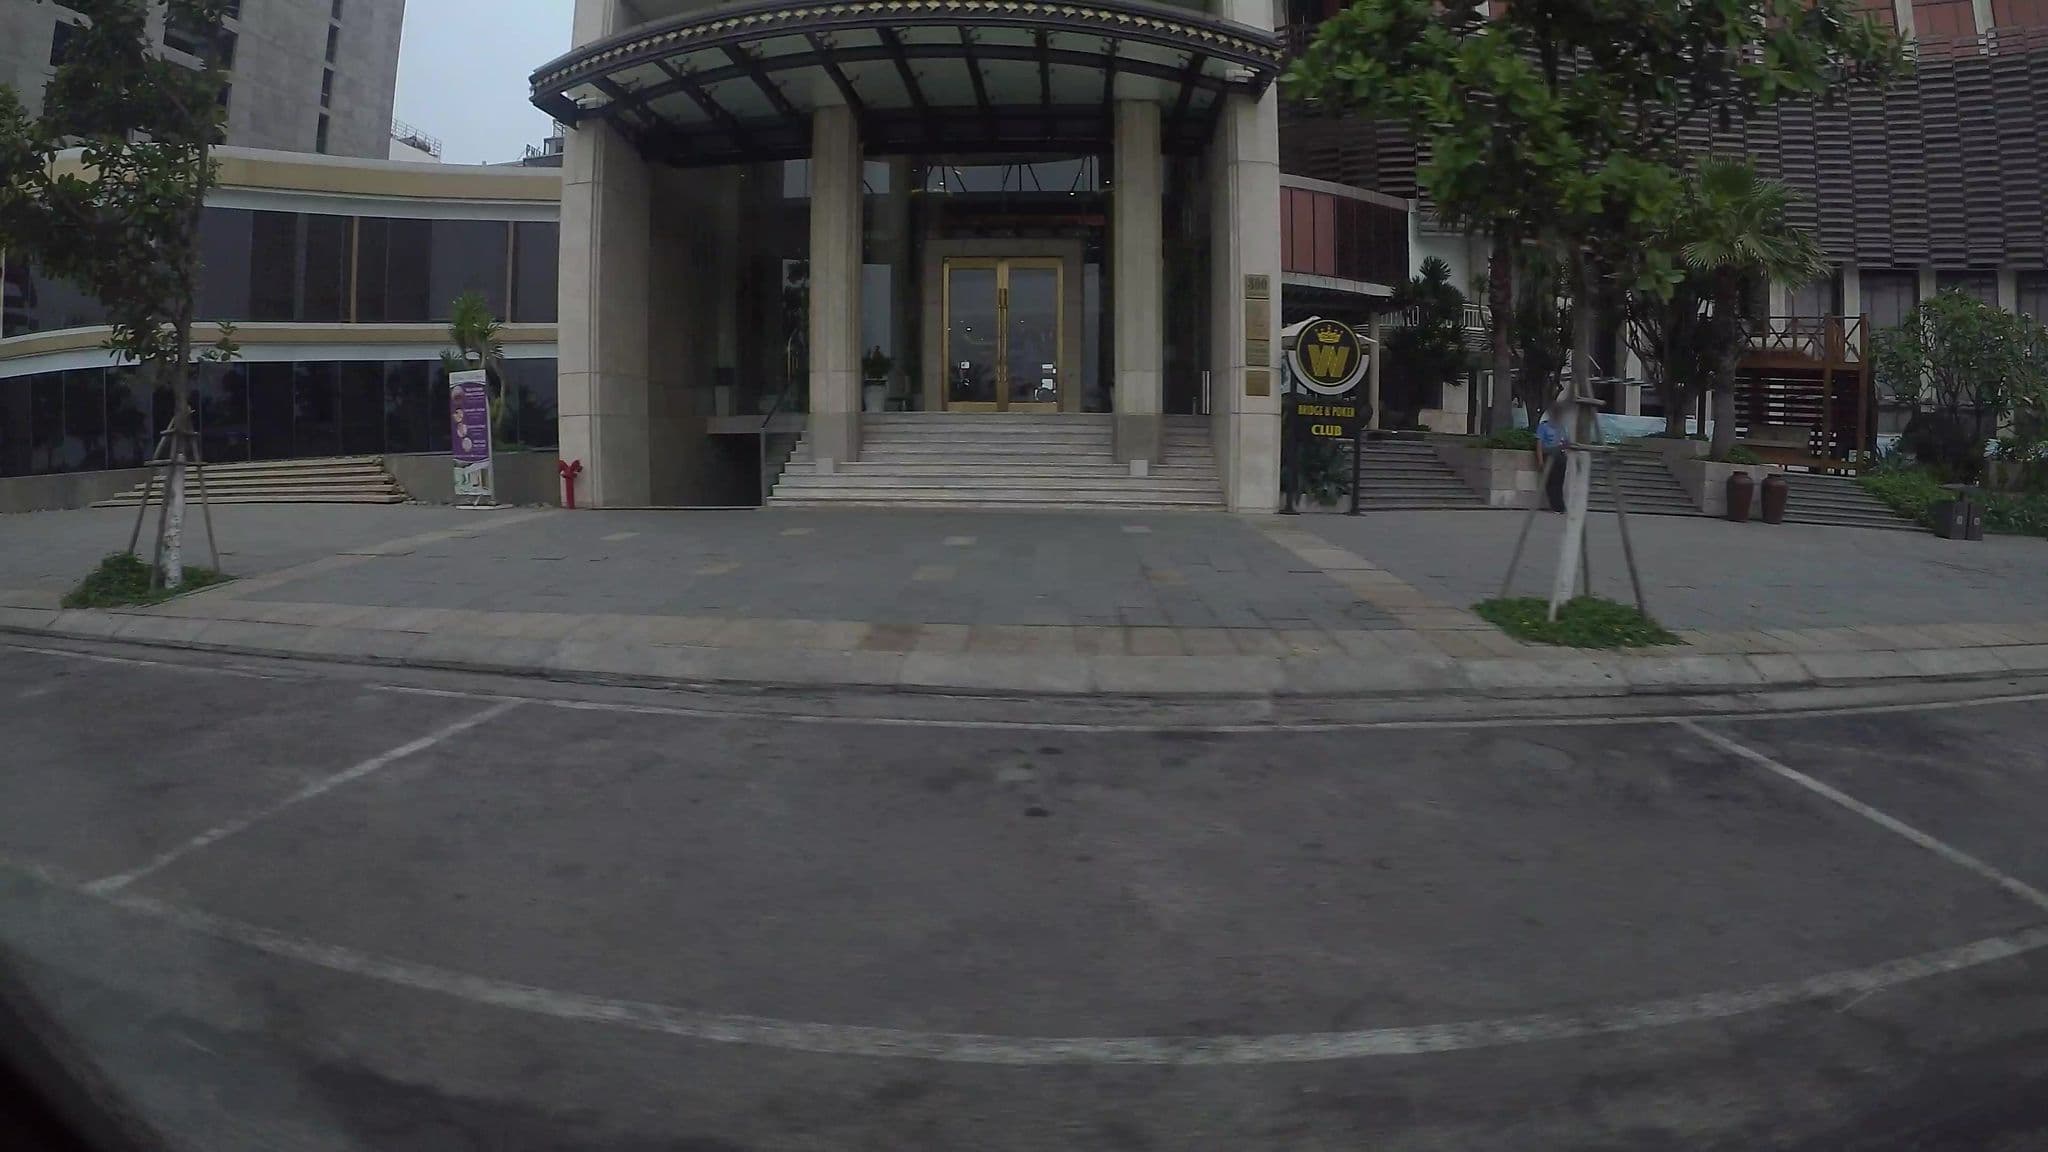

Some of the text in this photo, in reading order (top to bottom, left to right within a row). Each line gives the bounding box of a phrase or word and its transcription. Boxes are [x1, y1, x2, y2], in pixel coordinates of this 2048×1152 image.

[1298, 405, 1355, 417] BRIDGE & POKER
[1311, 424, 1342, 436] CLUB
